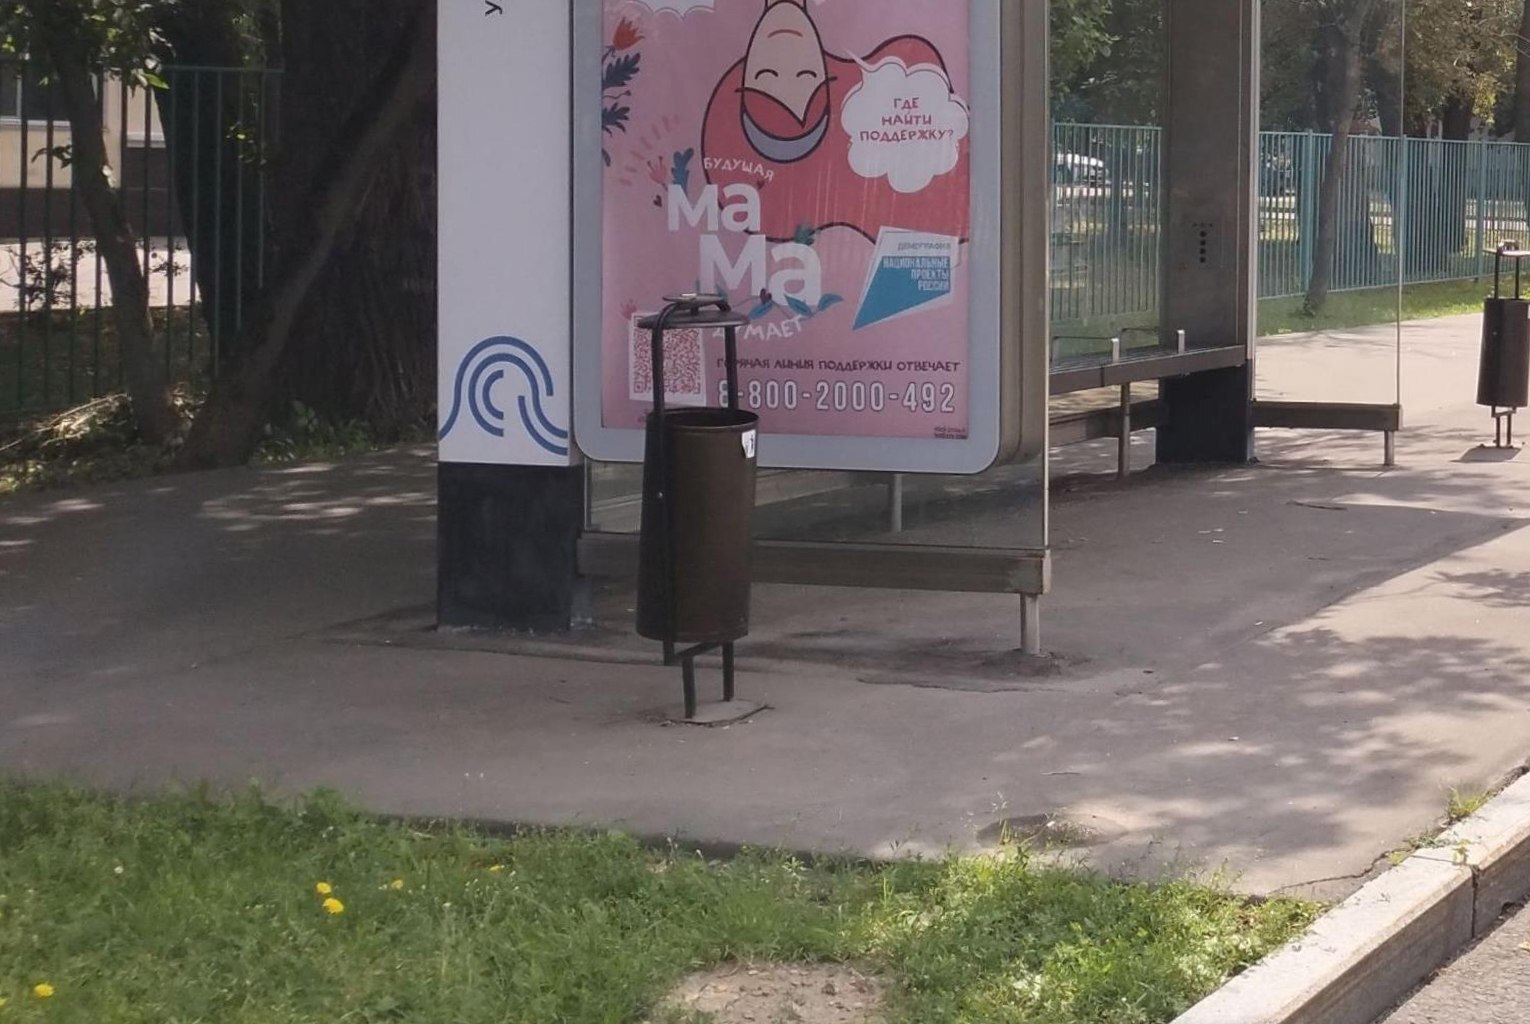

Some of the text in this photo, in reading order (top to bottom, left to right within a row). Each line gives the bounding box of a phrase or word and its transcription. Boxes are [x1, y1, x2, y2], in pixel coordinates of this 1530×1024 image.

[893, 97, 919, 110] ГДЕ
[881, 110, 932, 126] НАЙТИ
[859, 129, 954, 142] ПОДДЕРЖКУ?
[717, 359, 960, 372] ГЯЧАЯ ЛИНИЯ ПОДДЕРЖКИ ОТВЕЧАЕТ
[718, 379, 956, 413] 8-800-2000-492
